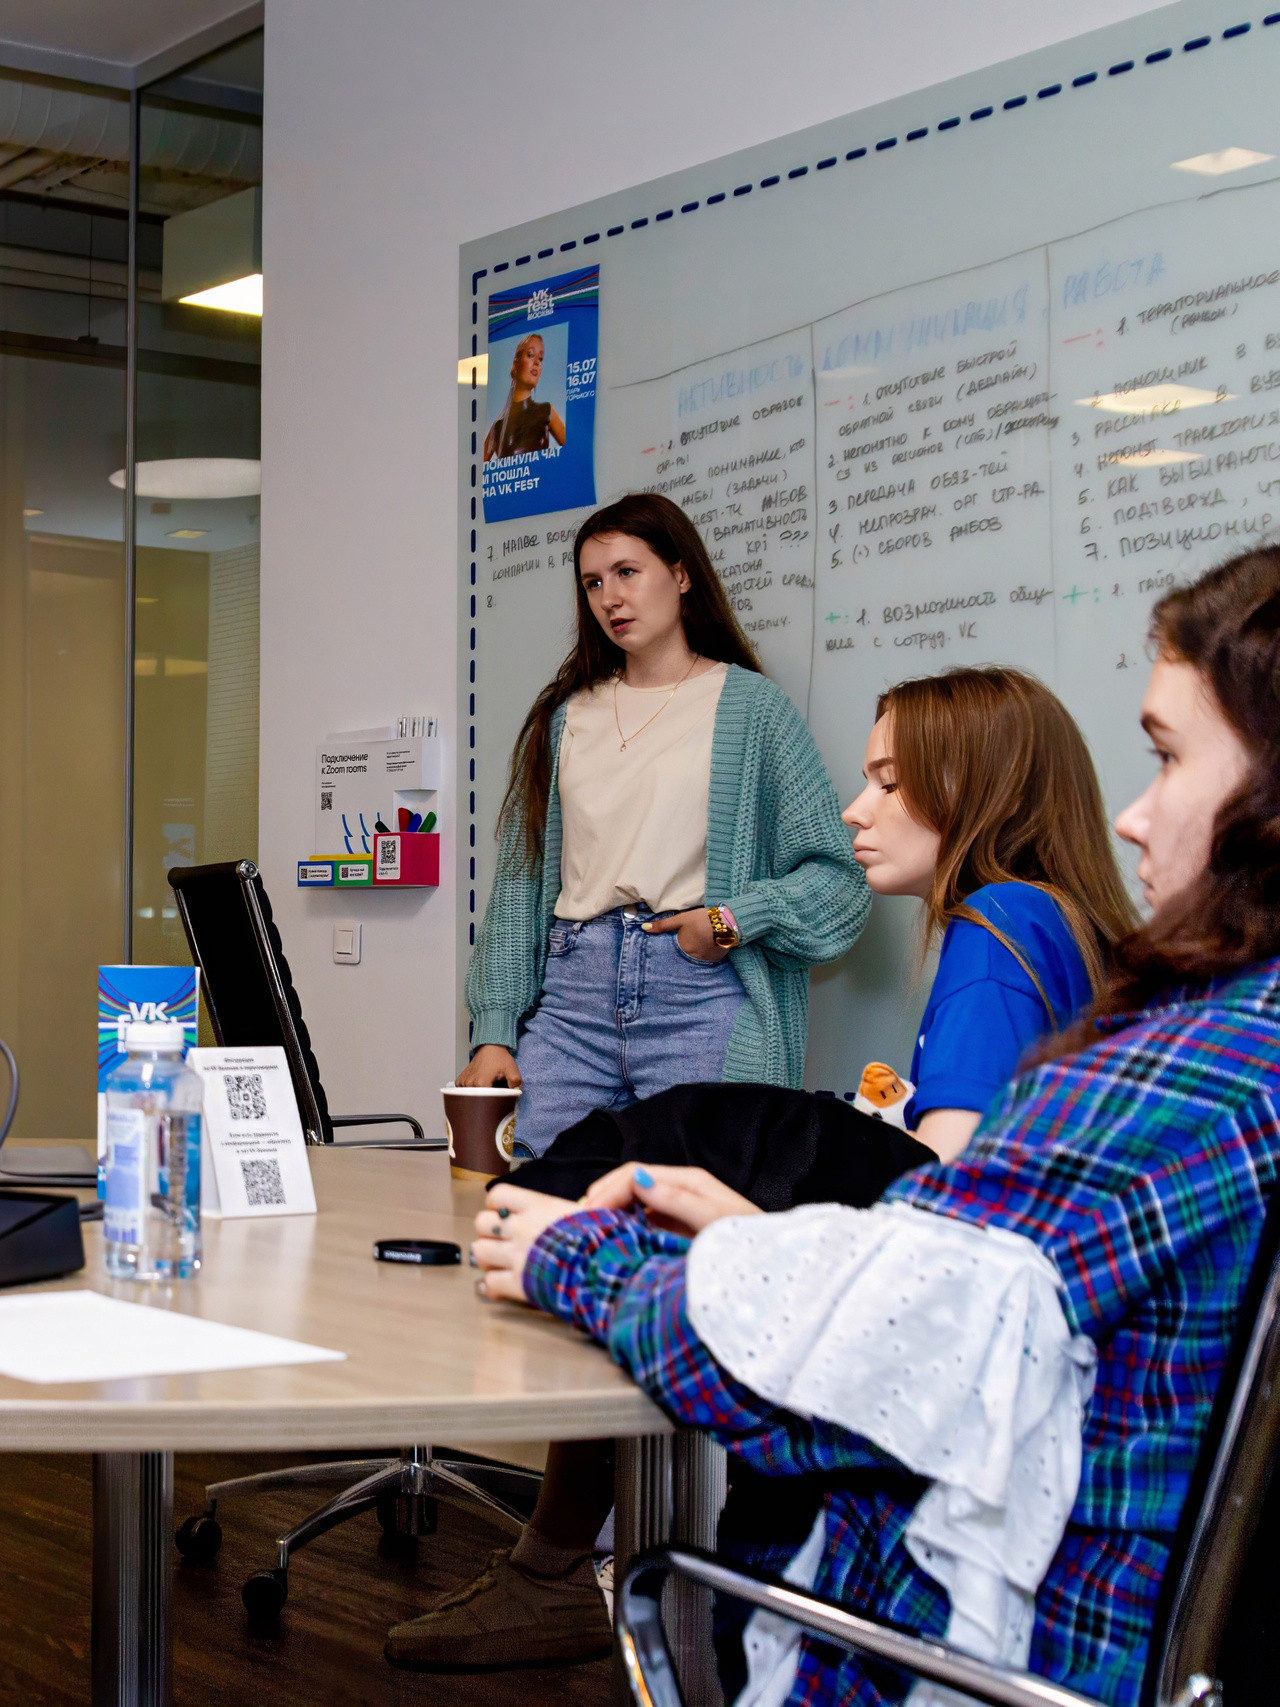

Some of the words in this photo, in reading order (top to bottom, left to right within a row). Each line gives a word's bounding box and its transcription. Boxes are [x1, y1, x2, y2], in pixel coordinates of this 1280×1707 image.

[532, 287, 550, 301] VK
[568, 358, 597, 374] 15.07
[567, 371, 597, 387] 16.07
[482, 450, 540, 472] ПОКИНУЛА
[541, 445, 563, 460] ЧАТ
[492, 466, 530, 484] ПОШЛА
[498, 483, 513, 495] VK
[515, 477, 540, 492] FEST
[1107, 473, 1139, 500] КАК
[321, 753, 368, 764] Подключение
[326, 765, 345, 775] Zoom
[346, 765, 368, 773] rooms
[128, 1001, 170, 1021] VK
